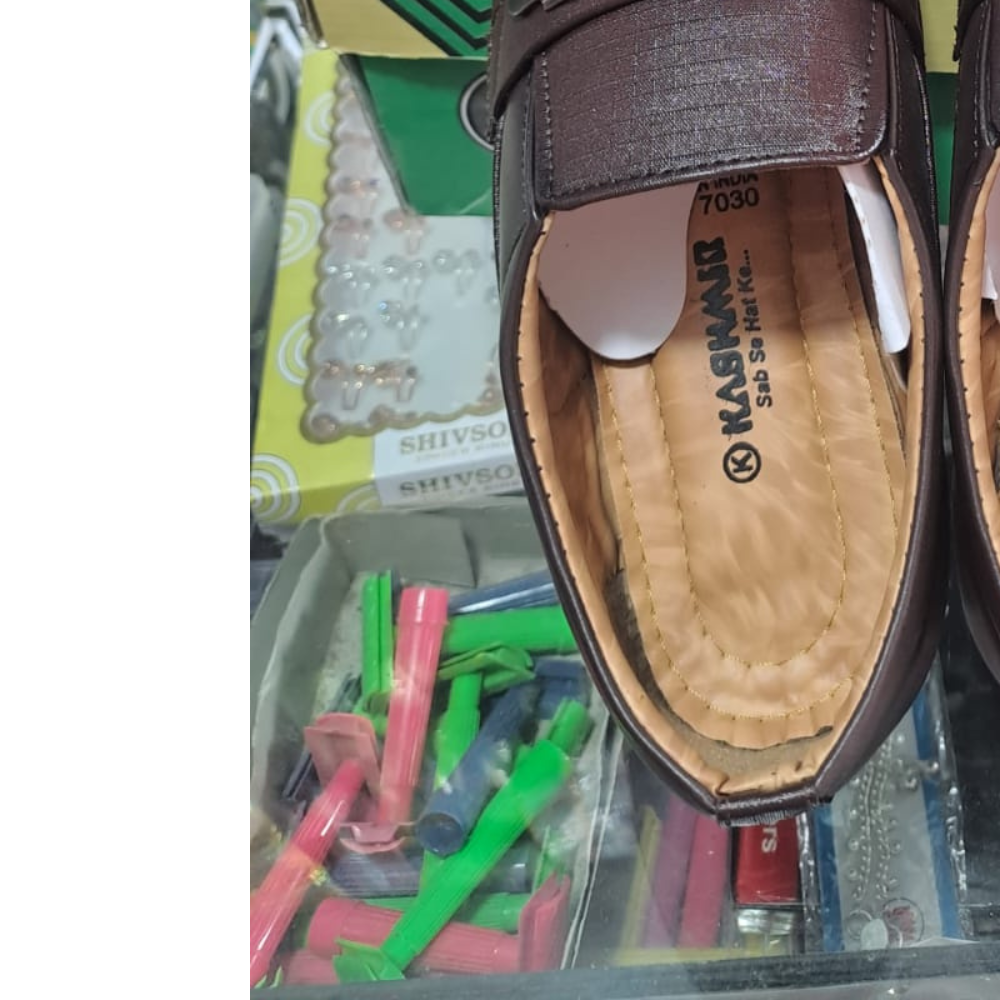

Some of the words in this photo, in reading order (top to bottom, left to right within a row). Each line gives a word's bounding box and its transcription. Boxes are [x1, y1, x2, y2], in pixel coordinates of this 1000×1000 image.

[699, 187, 760, 215] 7030
[741, 298, 762, 332] Hat
[692, 236, 754, 436] KASHMIR
[749, 337, 766, 364] Se
[752, 369, 773, 409] Sab
